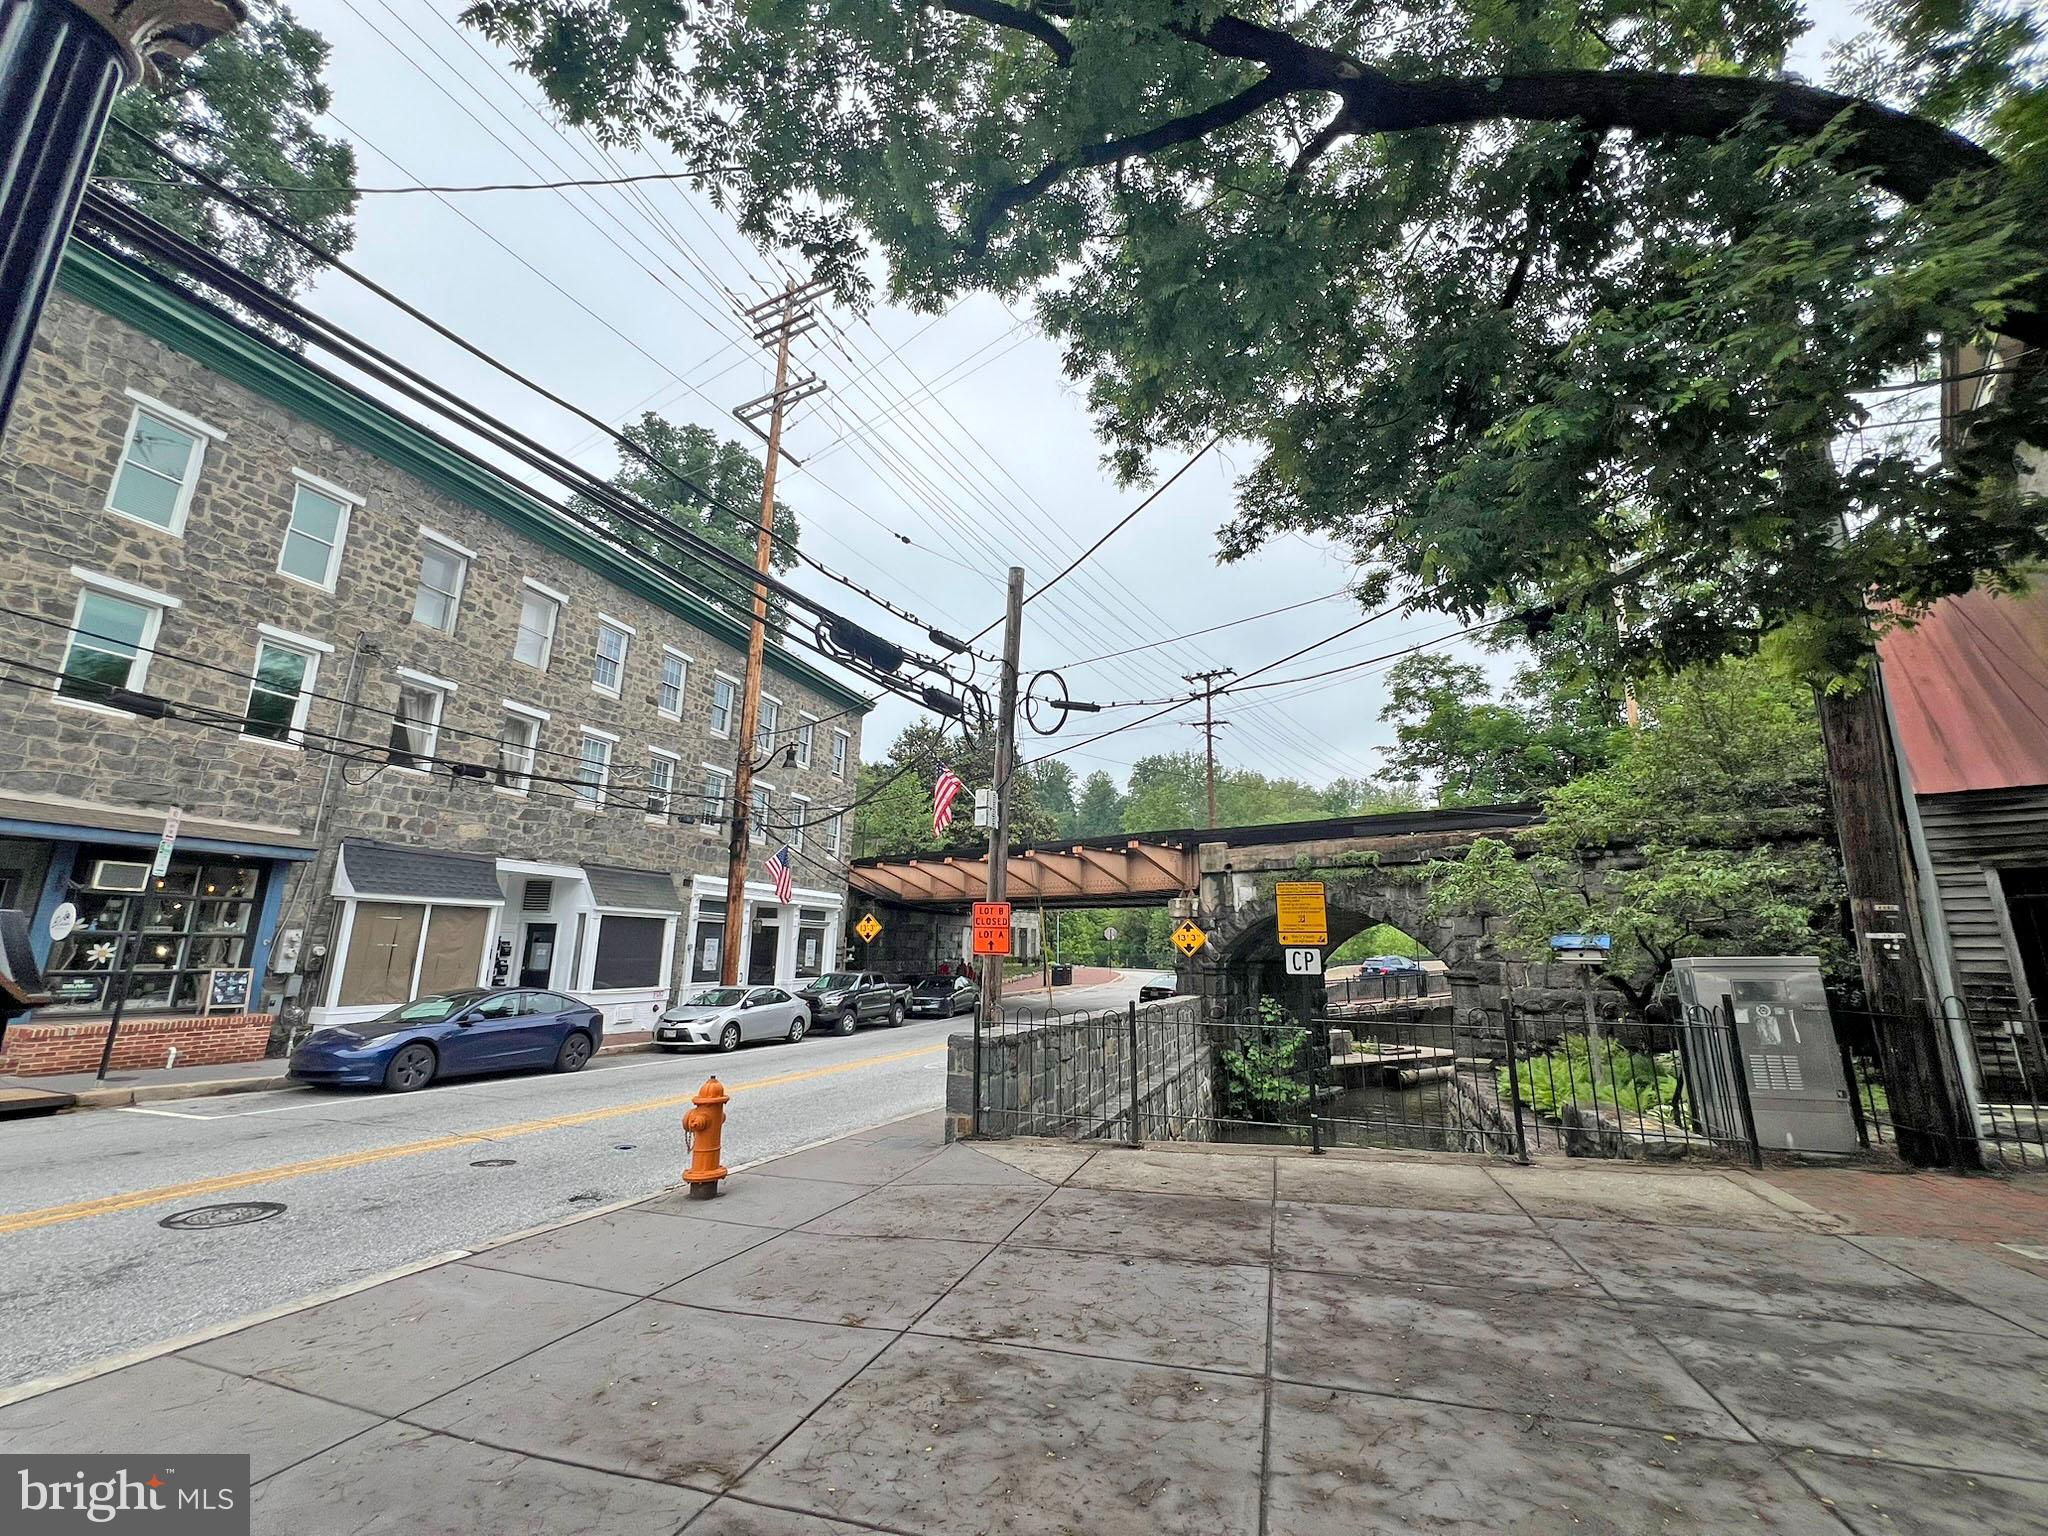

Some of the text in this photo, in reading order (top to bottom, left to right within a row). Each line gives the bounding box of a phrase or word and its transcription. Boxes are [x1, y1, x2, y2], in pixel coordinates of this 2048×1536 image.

[979, 907, 1004, 915] LOT B
[975, 917, 1008, 926] CLOSED
[978, 930, 1004, 939] LOT A
[1292, 951, 1314, 971] CP
